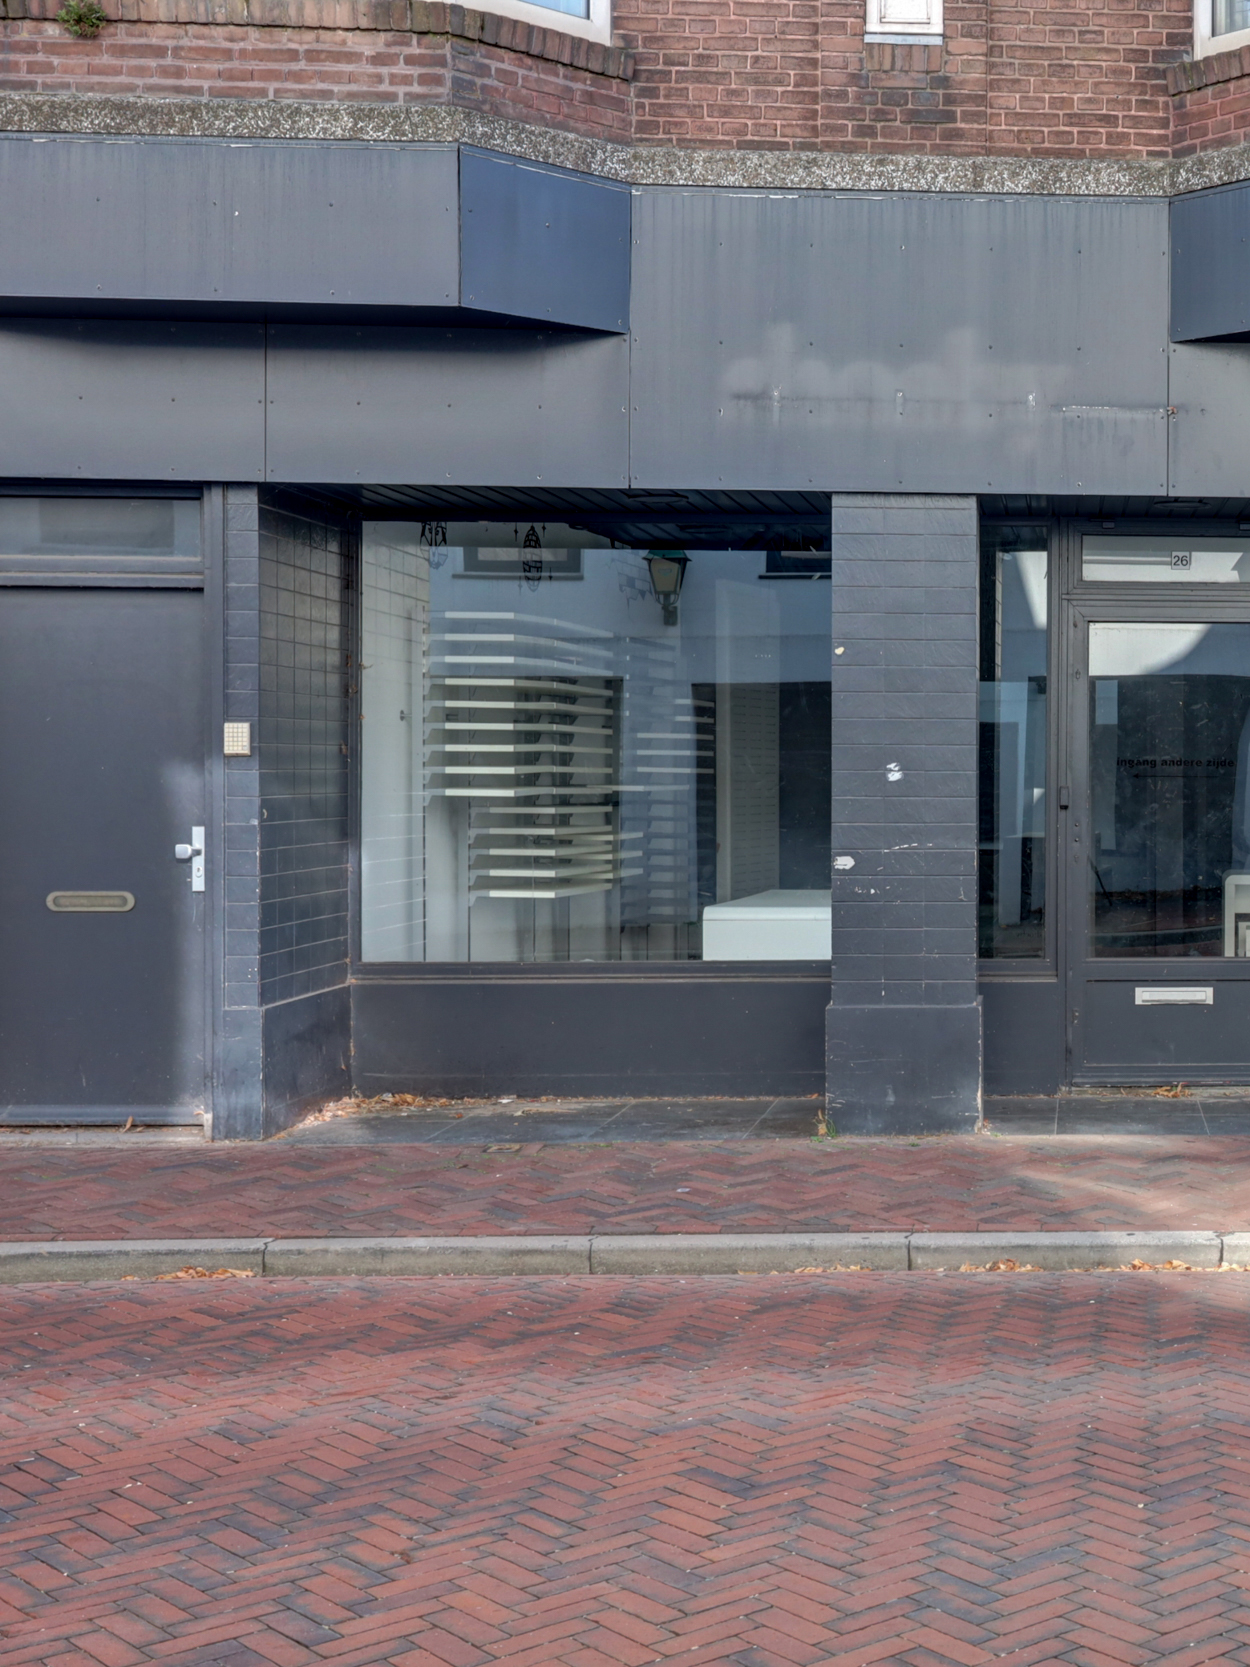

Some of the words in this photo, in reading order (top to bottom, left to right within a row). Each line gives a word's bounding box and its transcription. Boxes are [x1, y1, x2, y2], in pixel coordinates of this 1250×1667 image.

[1173, 555, 1188, 567] 26
[1116, 757, 1157, 769] ingang
[1160, 757, 1203, 767] andere
[1206, 757, 1235, 769] zijde
